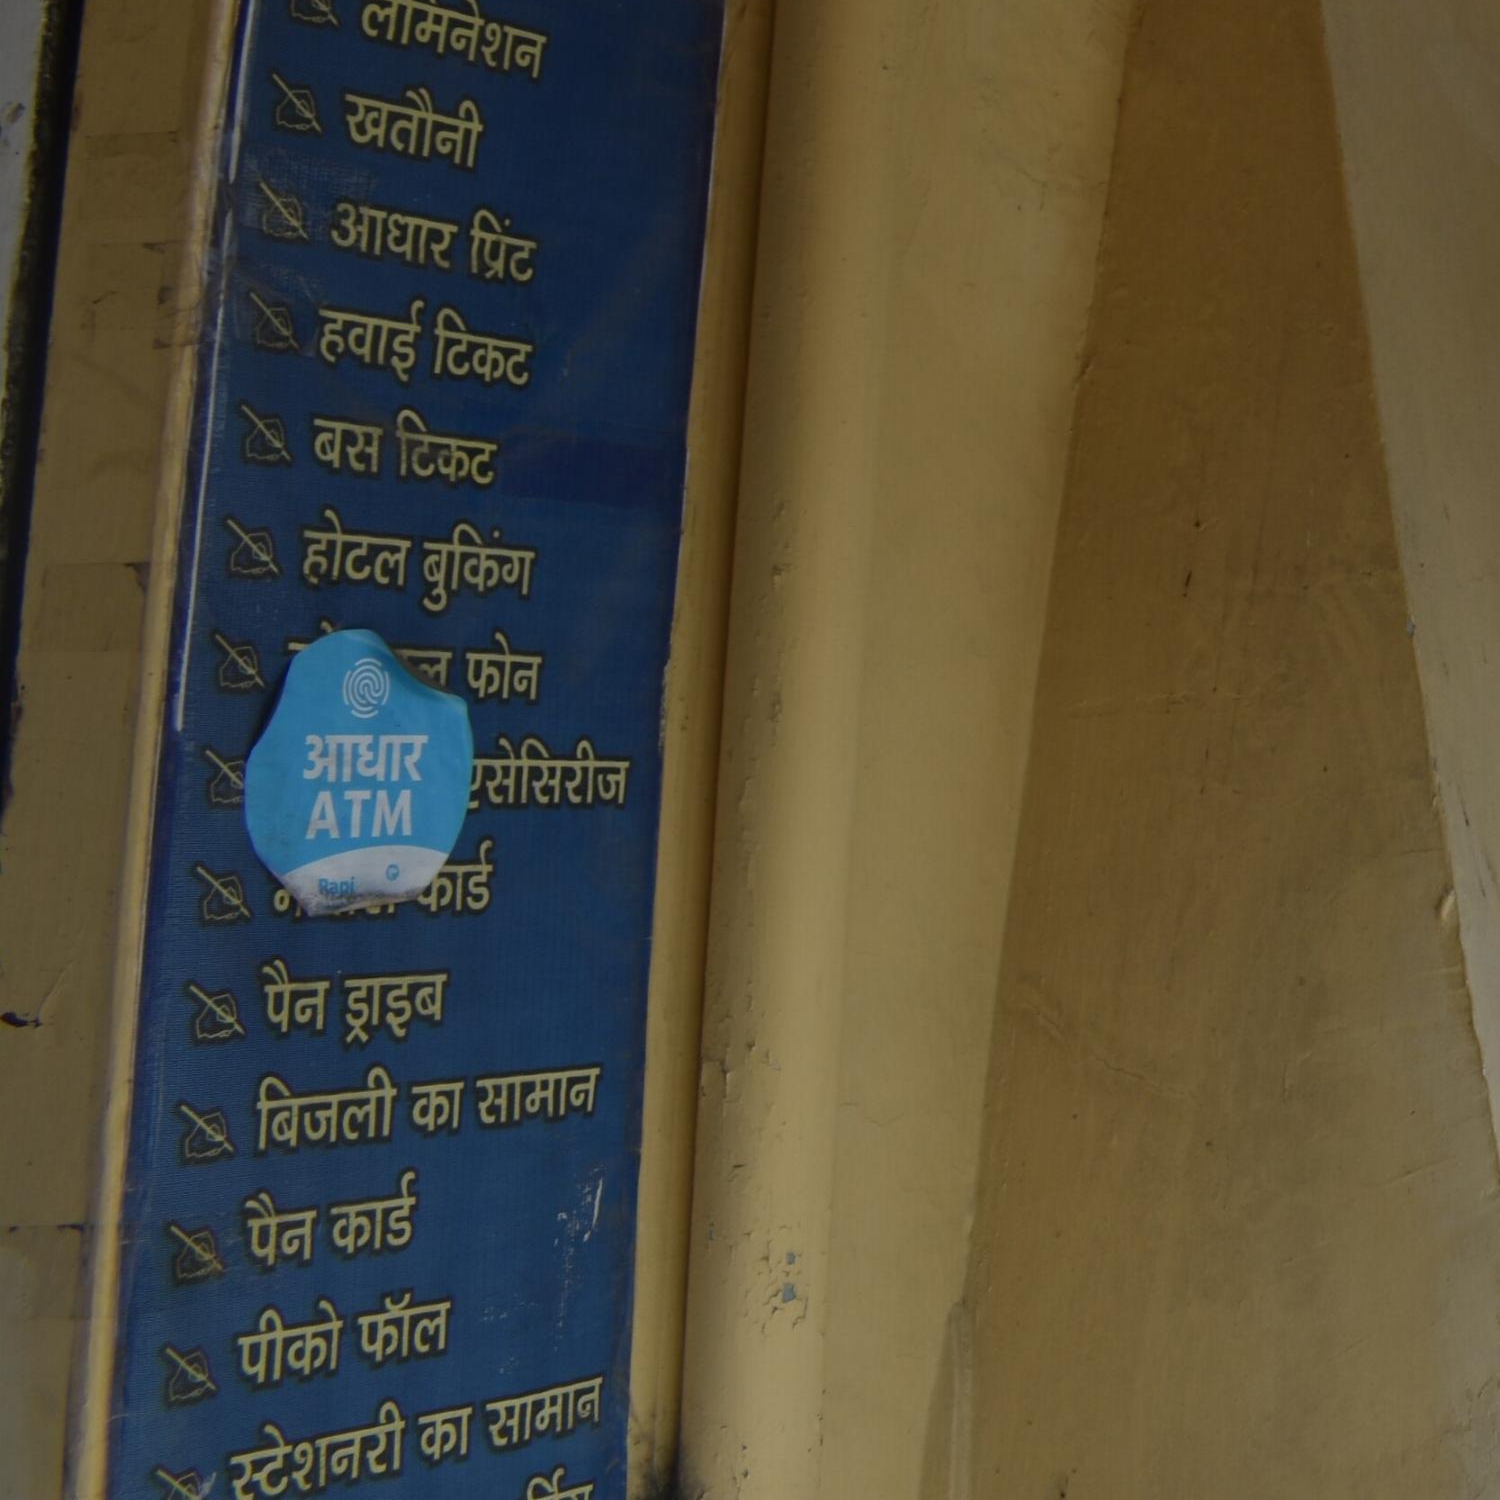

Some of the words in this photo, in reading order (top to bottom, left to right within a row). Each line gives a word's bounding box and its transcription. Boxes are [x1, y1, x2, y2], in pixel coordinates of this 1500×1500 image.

[346, 90, 484, 166] खतौनी
[330, 203, 457, 269] आधार
[470, 210, 535, 284] प्रिंट
[320, 300, 423, 381] हवाई
[434, 307, 532, 386] टिकट
[314, 419, 384, 472] बस
[397, 409, 497, 487] टिकट
[303, 510, 411, 587] होटल
[423, 523, 535, 613] बुकिंग
[466, 632, 542, 699] फोन
[303, 735, 428, 782] आधार
[305, 790, 412, 840] ATM
[416, 841, 493, 915] कार्ड
[263, 959, 329, 1032] पैन
[258, 1066, 396, 1150] बिजली
[413, 1081, 465, 1131] का
[477, 1066, 600, 1125] सामान
[245, 1193, 318, 1268] पैन
[330, 1171, 417, 1255] कार्ड
[238, 1299, 343, 1383] पीको
[357, 1293, 451, 1359] फॉल
[231, 1401, 406, 1500] स्टेशनरी
[420, 1407, 473, 1459] का
[486, 1377, 602, 1447] सामान
